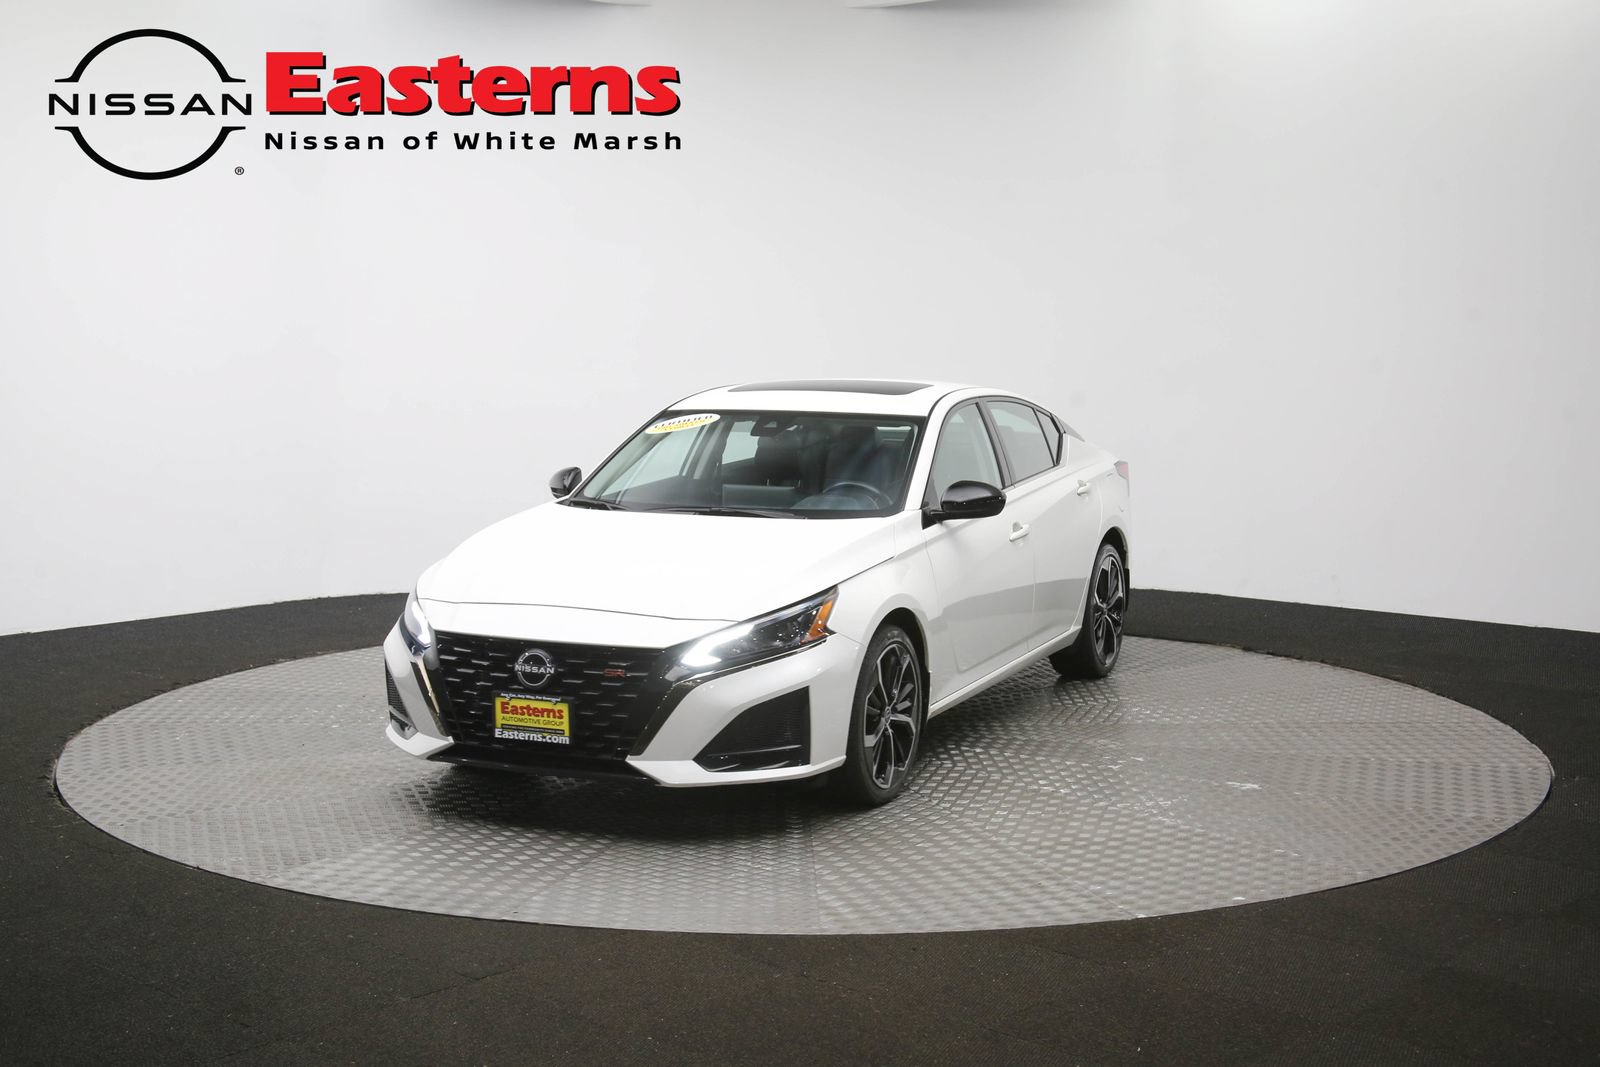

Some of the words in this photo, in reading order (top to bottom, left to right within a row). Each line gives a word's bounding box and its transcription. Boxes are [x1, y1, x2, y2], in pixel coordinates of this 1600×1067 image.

[514, 664, 555, 674] NISSAN
[500, 701, 564, 720] Easterns
[501, 716, 542, 725] AUTOMOTIVE
[543, 719, 565, 727] GROUP
[494, 728, 570, 744] Easterns.com
